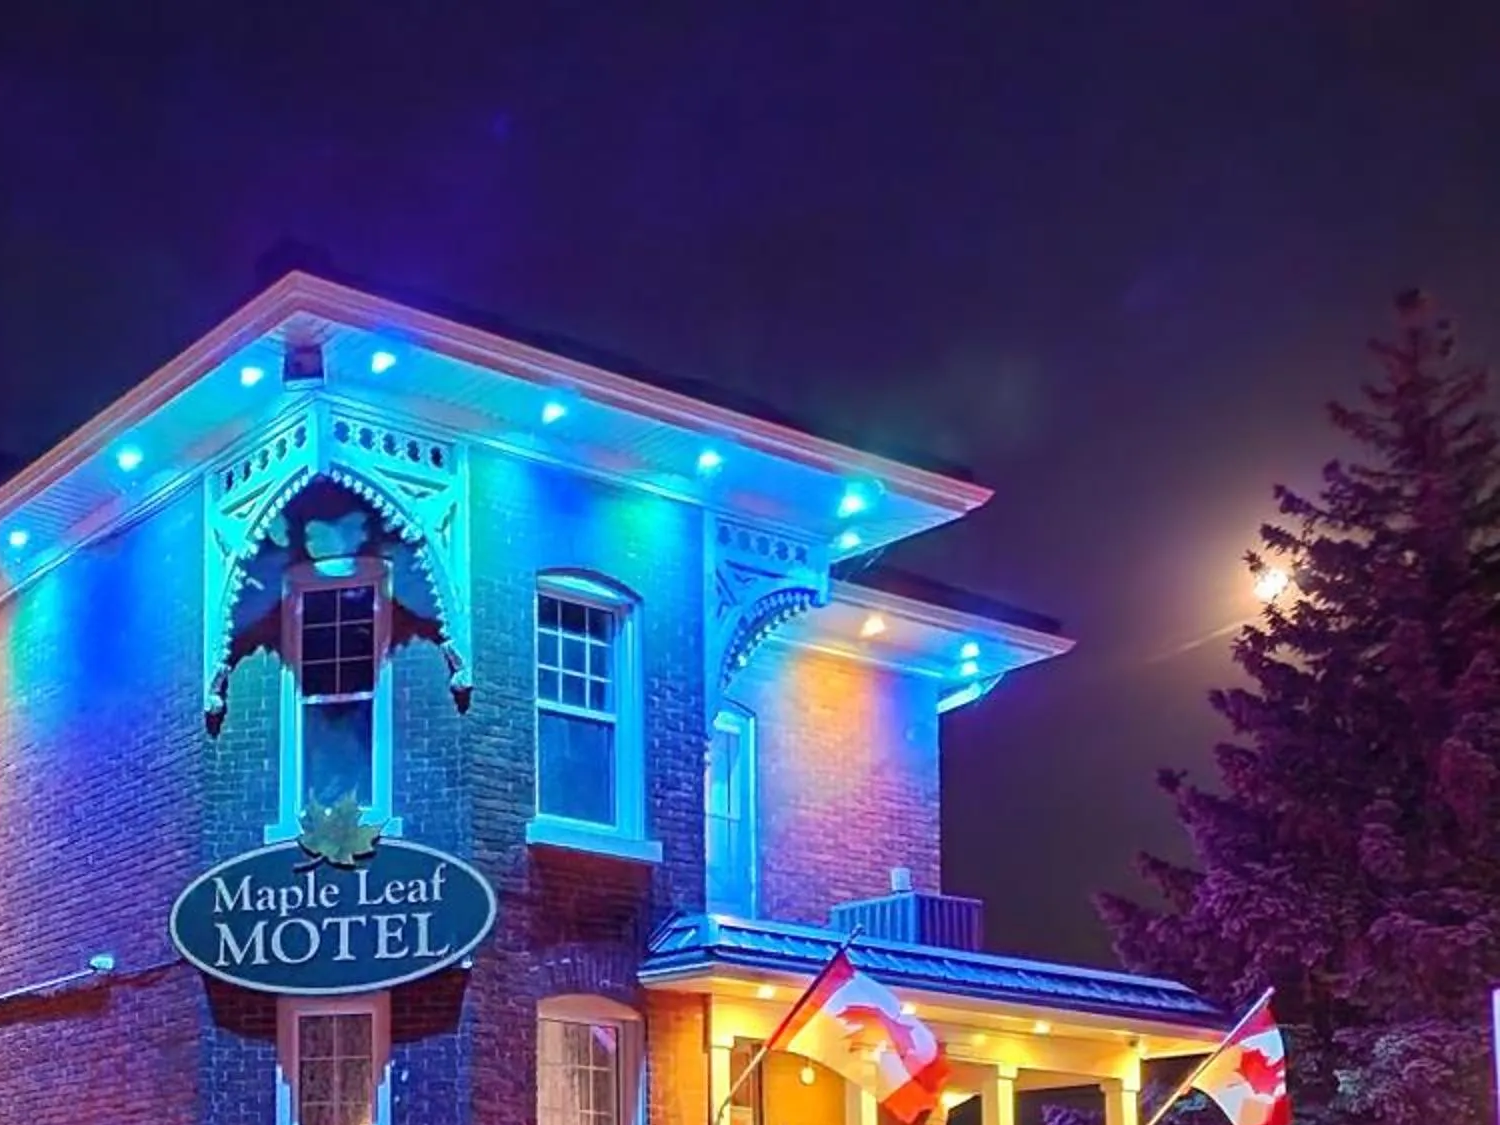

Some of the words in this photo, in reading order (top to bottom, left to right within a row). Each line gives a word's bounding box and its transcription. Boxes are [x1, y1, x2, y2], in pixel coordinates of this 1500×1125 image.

[212, 870, 340, 916] Maple
[355, 863, 447, 906] Leaf
[215, 912, 451, 967] MOTEL
